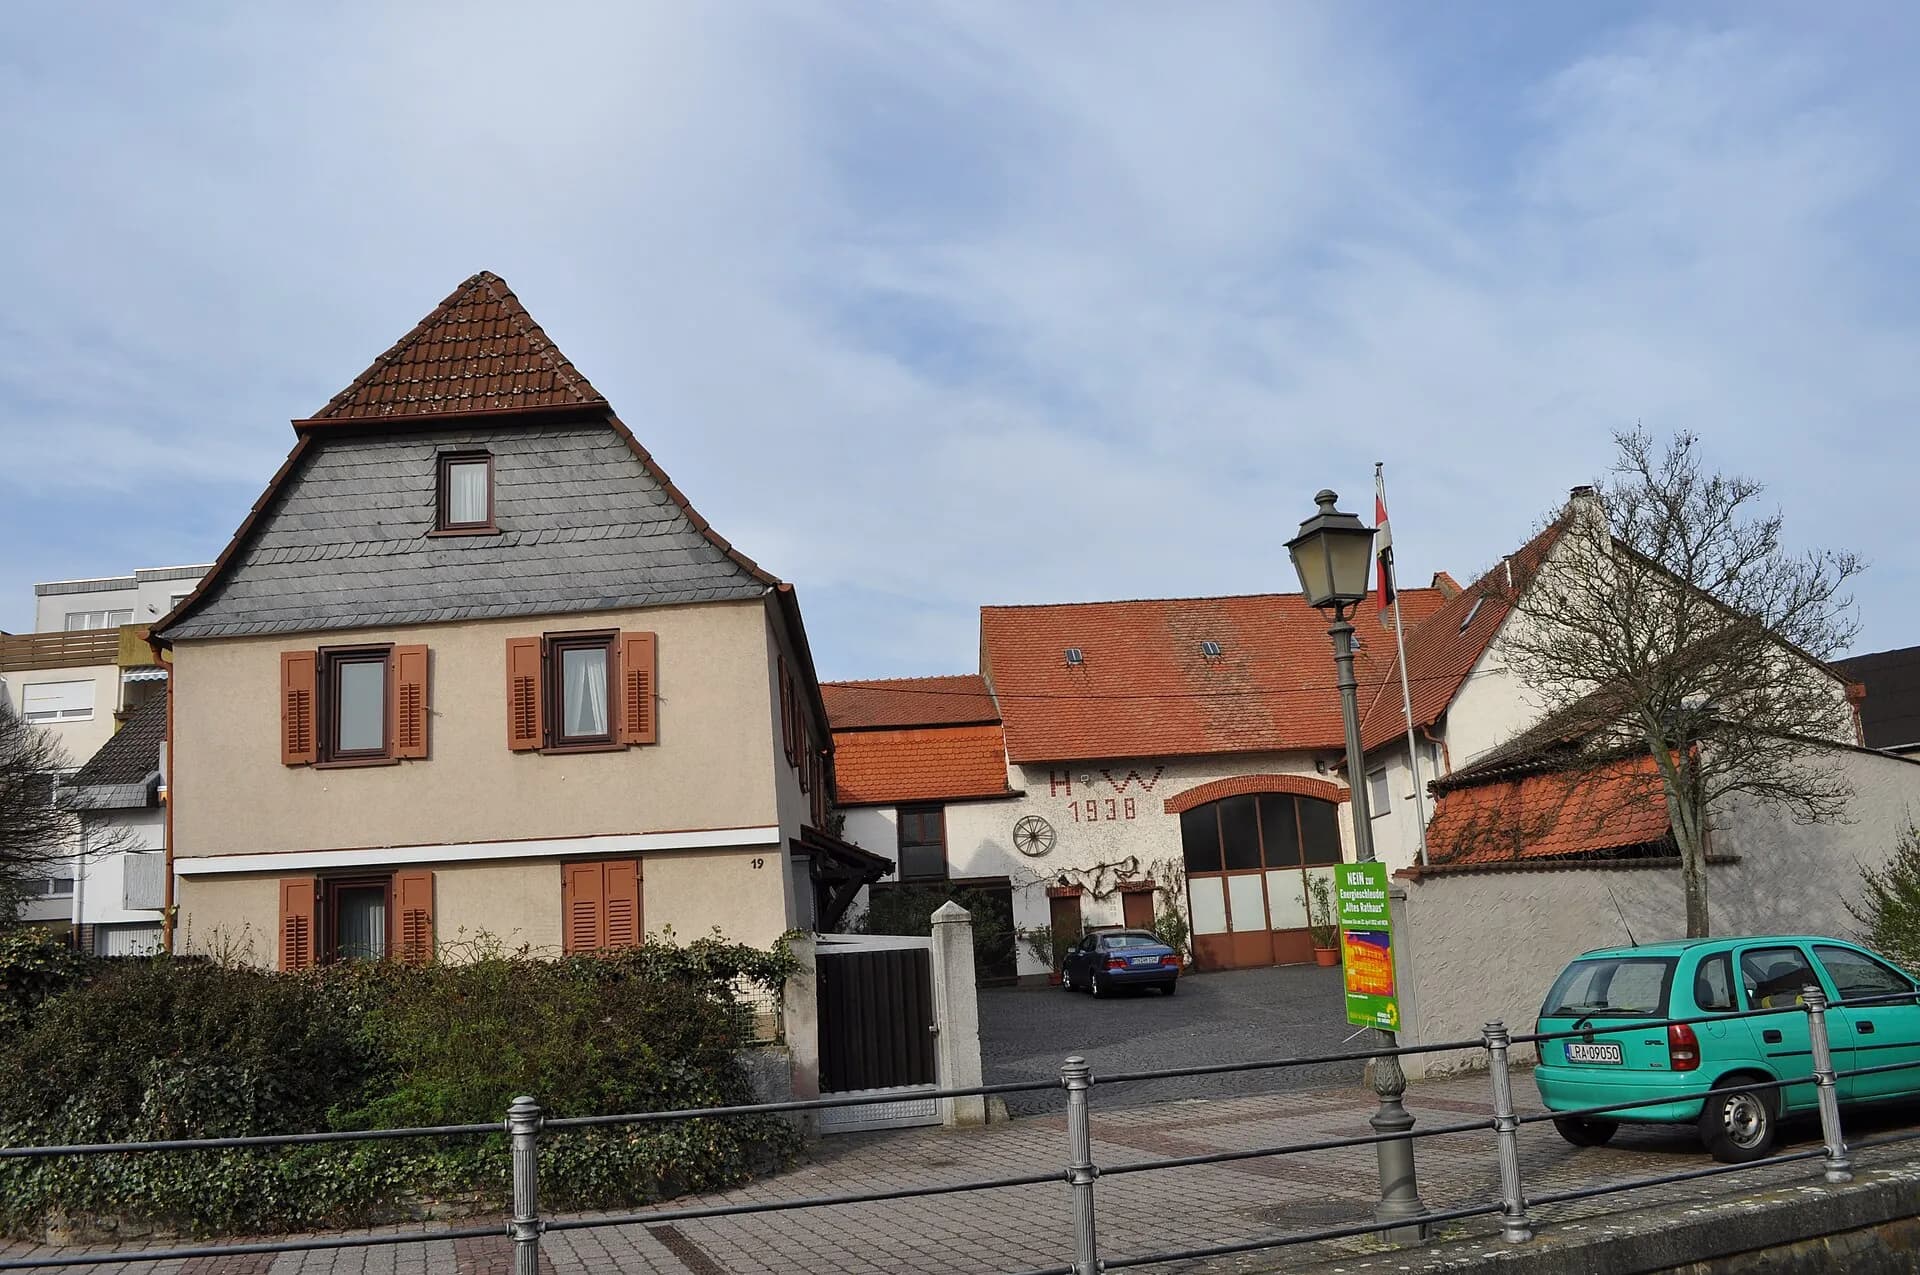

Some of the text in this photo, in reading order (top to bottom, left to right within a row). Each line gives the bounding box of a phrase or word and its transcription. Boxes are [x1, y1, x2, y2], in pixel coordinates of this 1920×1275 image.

[1050, 770, 1071, 797] H
[1067, 798, 1136, 822] 1938
[750, 858, 764, 869] 19
[1347, 872, 1364, 885] NEIN
[1571, 1046, 1619, 1060] LRA 09050
